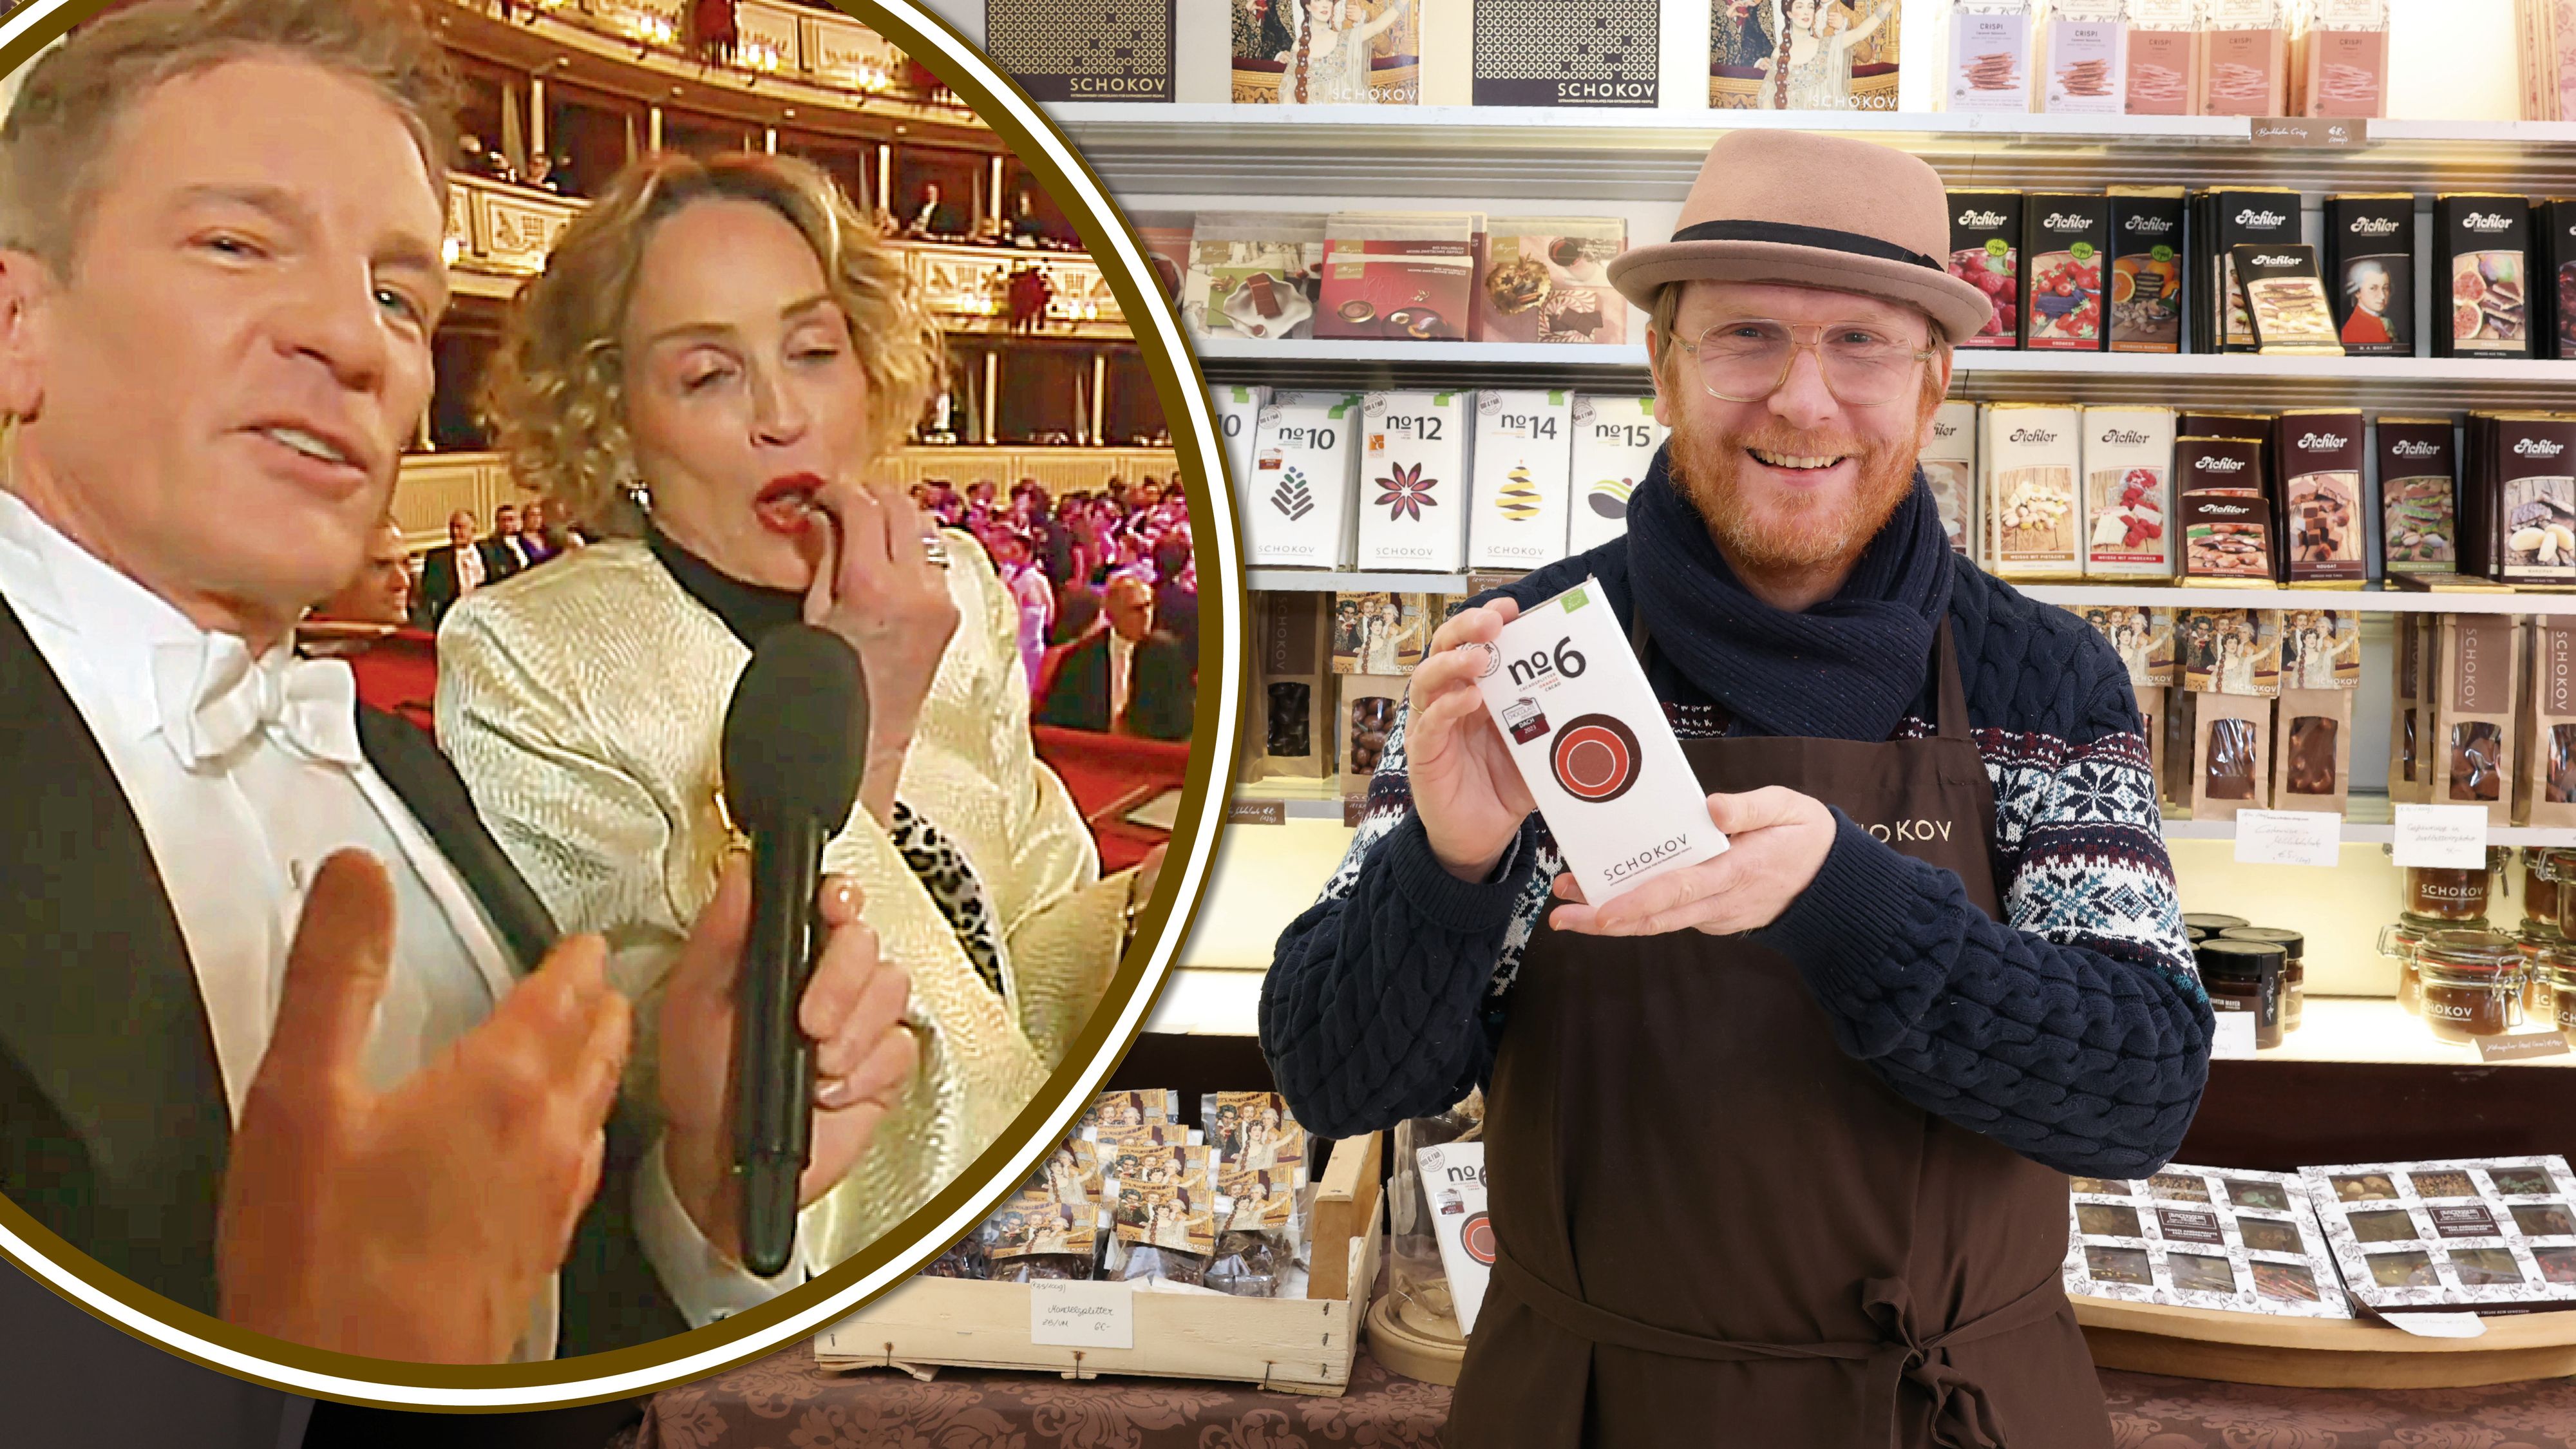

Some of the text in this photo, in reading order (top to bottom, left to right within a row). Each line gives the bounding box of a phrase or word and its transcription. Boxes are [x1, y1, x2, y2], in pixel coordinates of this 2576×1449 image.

[1070, 78, 1165, 91] SCHOKOV
[1558, 83, 1654, 97] SCHOKOV
[1332, 88, 1416, 101] SCHOKOV
[1812, 95, 1896, 109] SCHOKOV
[1958, 210, 2007, 226] Pichler
[2043, 213, 2092, 229] Pichler
[2125, 215, 2173, 231] Pichler
[2235, 209, 2286, 226] Pichler
[2351, 216, 2399, 232] Pichler
[2463, 213, 2513, 229] Pichler
[2251, 255, 2302, 265] Pichler
[2010, 428, 2057, 443] Pichler
[2101, 429, 2150, 444] Pichler
[2298, 433, 2347, 449] Pichler
[2392, 440, 2440, 455] Pichler
[2514, 438, 2564, 455] Pichler
[2195, 456, 2244, 471] Pichler
[2199, 504, 2249, 514] Pichler
[1258, 545, 1315, 553] SCHOKOV
[1376, 547, 1433, 556] SCHOKOV
[1488, 546, 1544, 556] SCHOKOV
[1276, 596, 1288, 670] SCHOKOV
[2465, 628, 2477, 708] SCHOKOV
[2556, 631, 2568, 710] SCHOKOV
[1519, 672, 1556, 692] CACAOSPLITTER
[1539, 677, 1559, 689] ORANGE
[1545, 681, 1561, 692] CACAO
[1519, 717, 1535, 728] DACH
[1604, 833, 1686, 881] SCHOKOV
[2422, 884, 2483, 896] SCHOKOV
